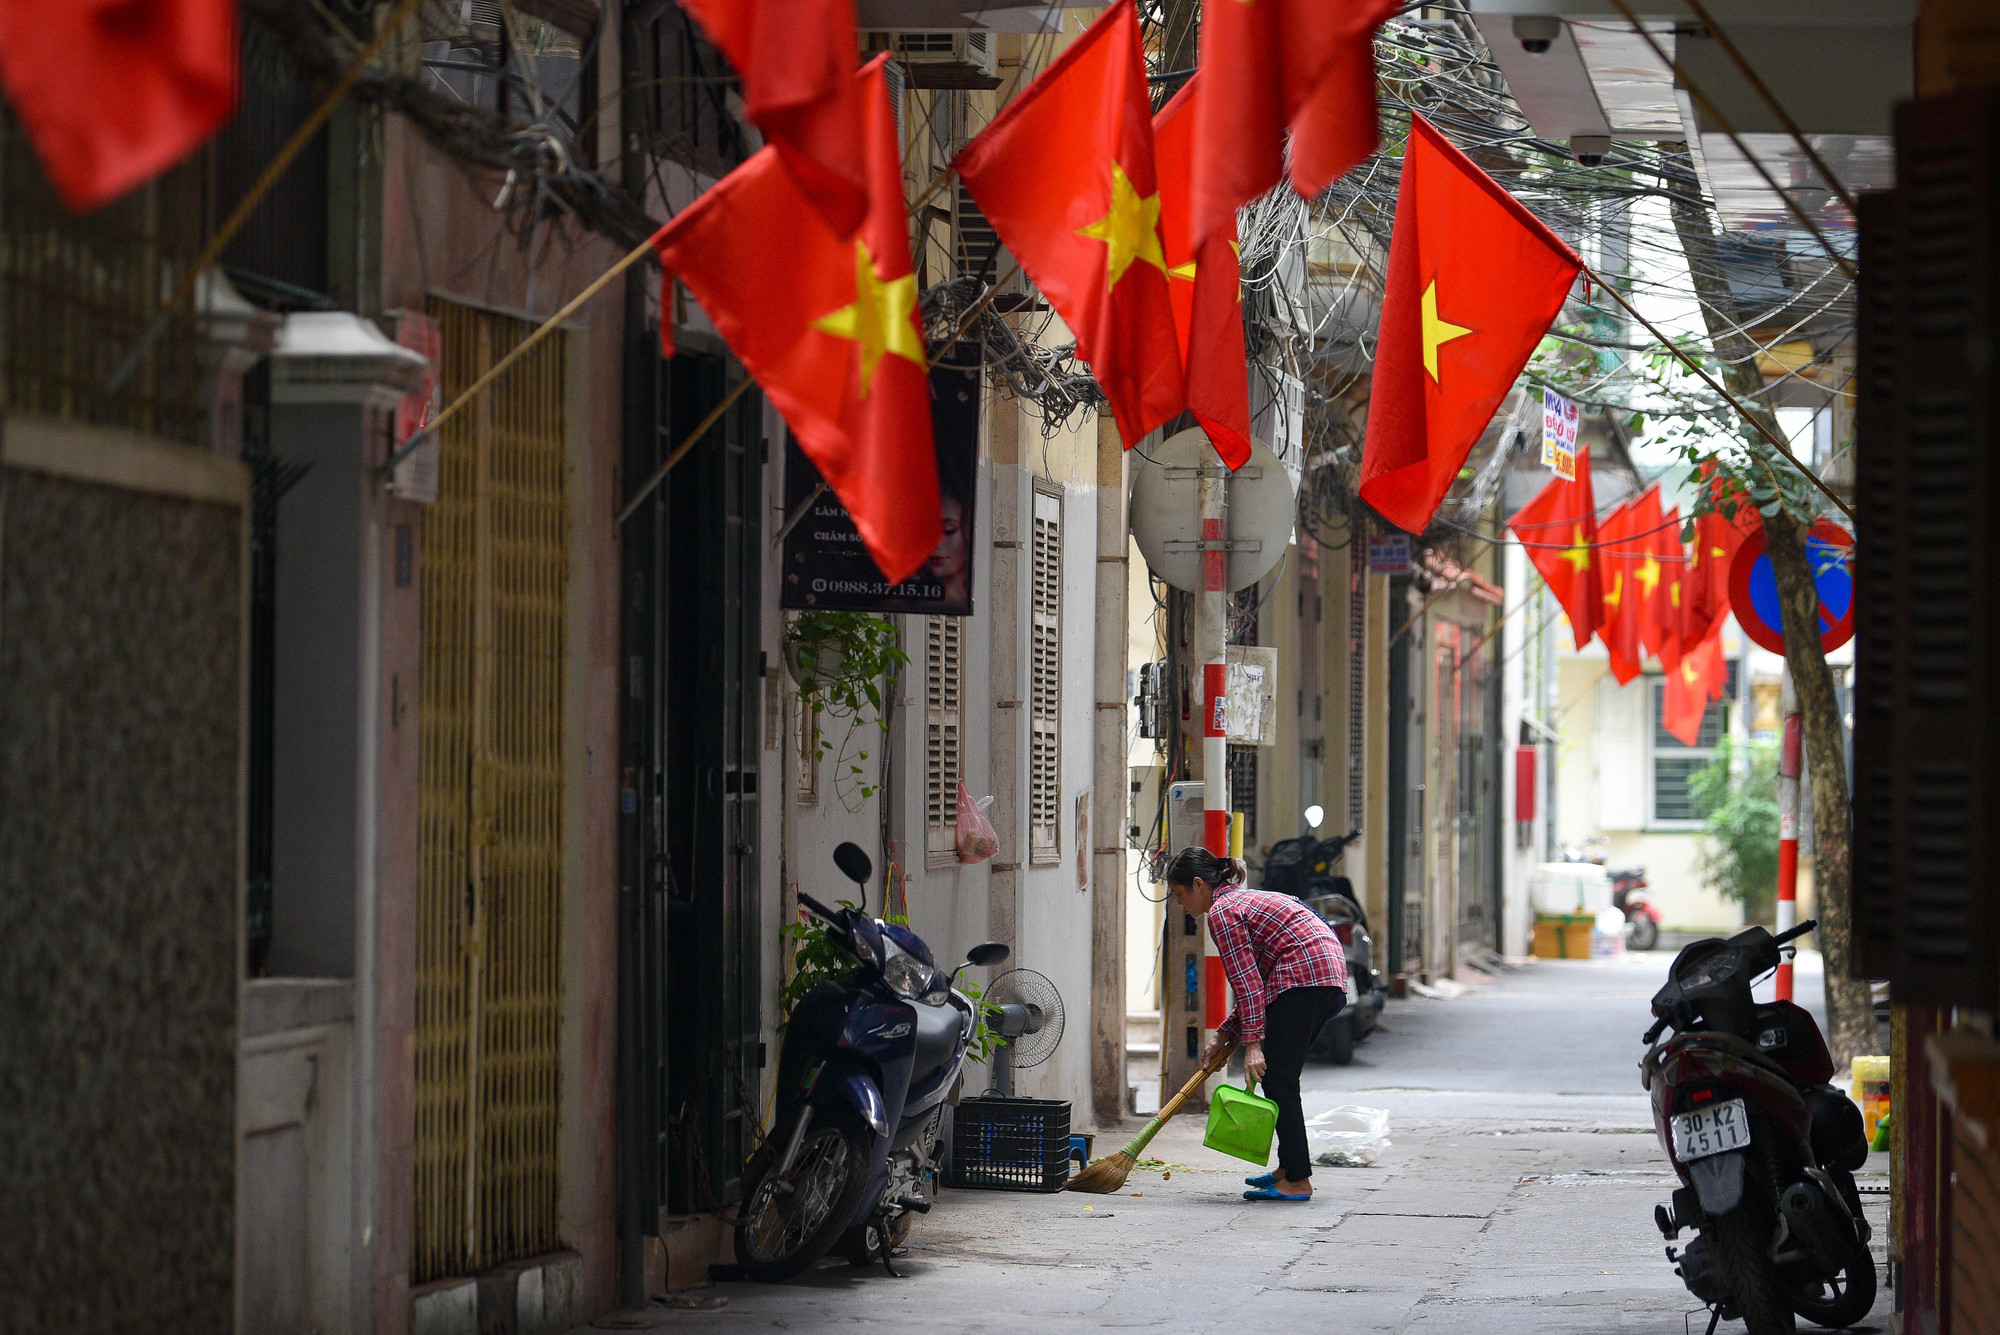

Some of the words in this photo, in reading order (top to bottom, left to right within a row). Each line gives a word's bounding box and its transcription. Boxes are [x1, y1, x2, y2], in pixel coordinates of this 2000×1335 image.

[829, 580, 942, 598] 0988.37.15.16
[1682, 1105, 1735, 1135] 30-K2
[1686, 1126, 1738, 1155] 4511
